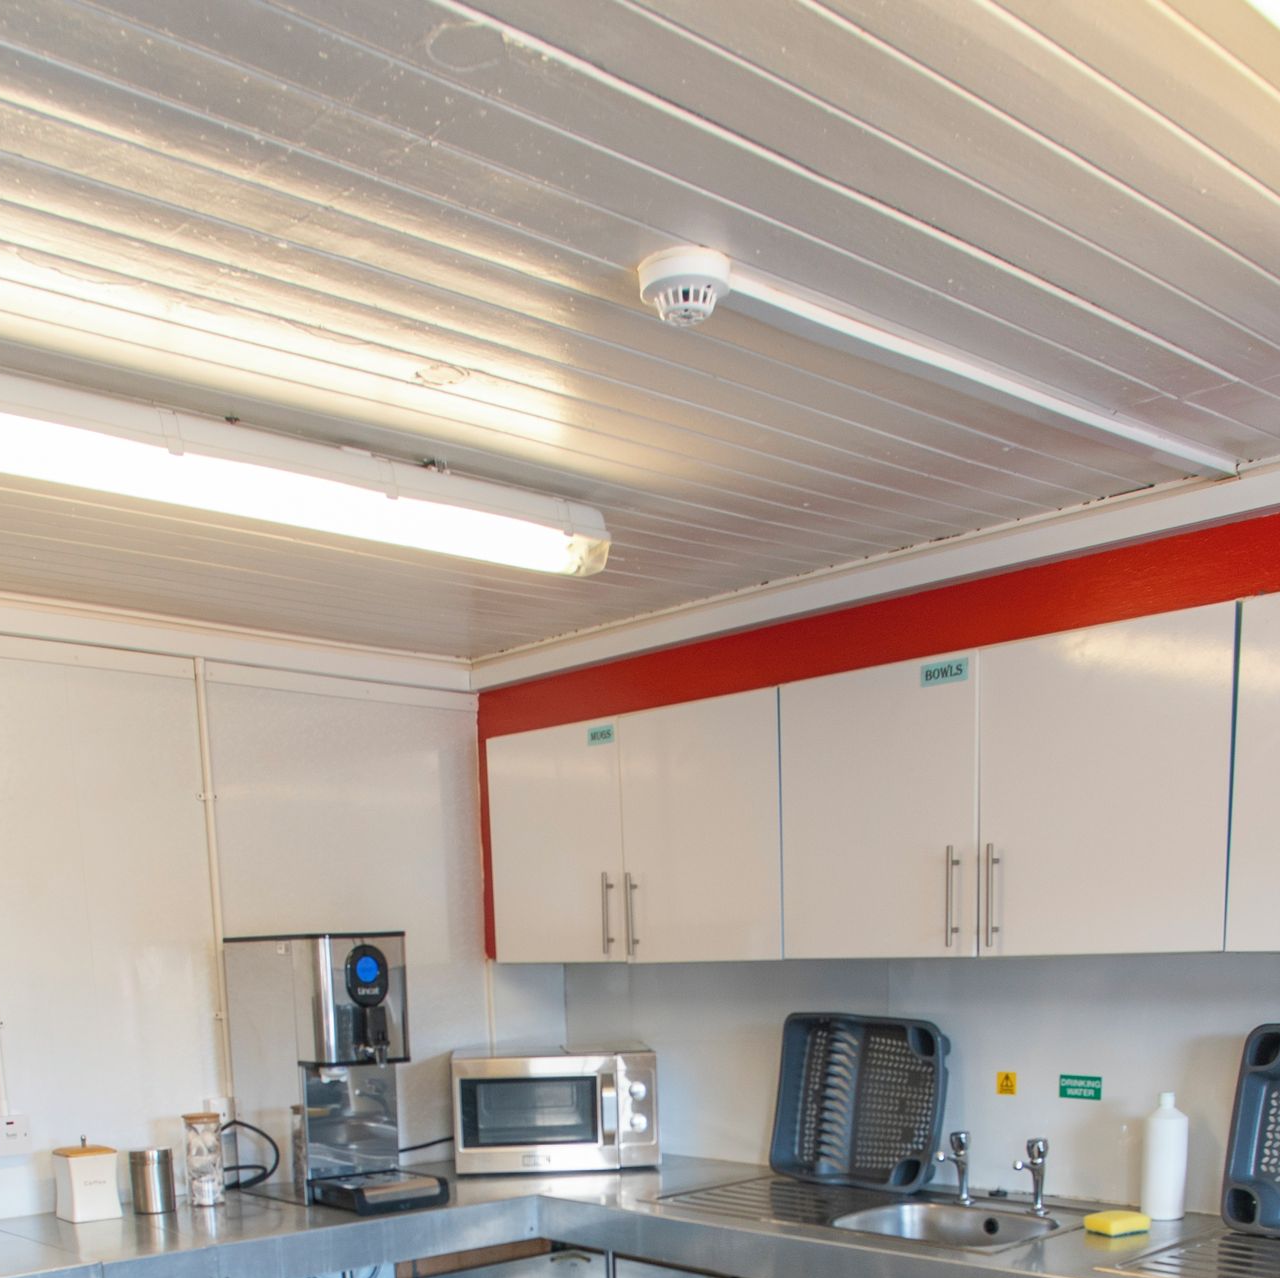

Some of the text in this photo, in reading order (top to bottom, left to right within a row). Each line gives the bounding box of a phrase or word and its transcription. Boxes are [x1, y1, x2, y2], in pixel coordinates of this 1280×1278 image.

[925, 663, 963, 681] BOWLS
[590, 729, 611, 741] MUGS
[1061, 1078, 1101, 1089] DRINKING
[1066, 1087, 1095, 1097] WATER
